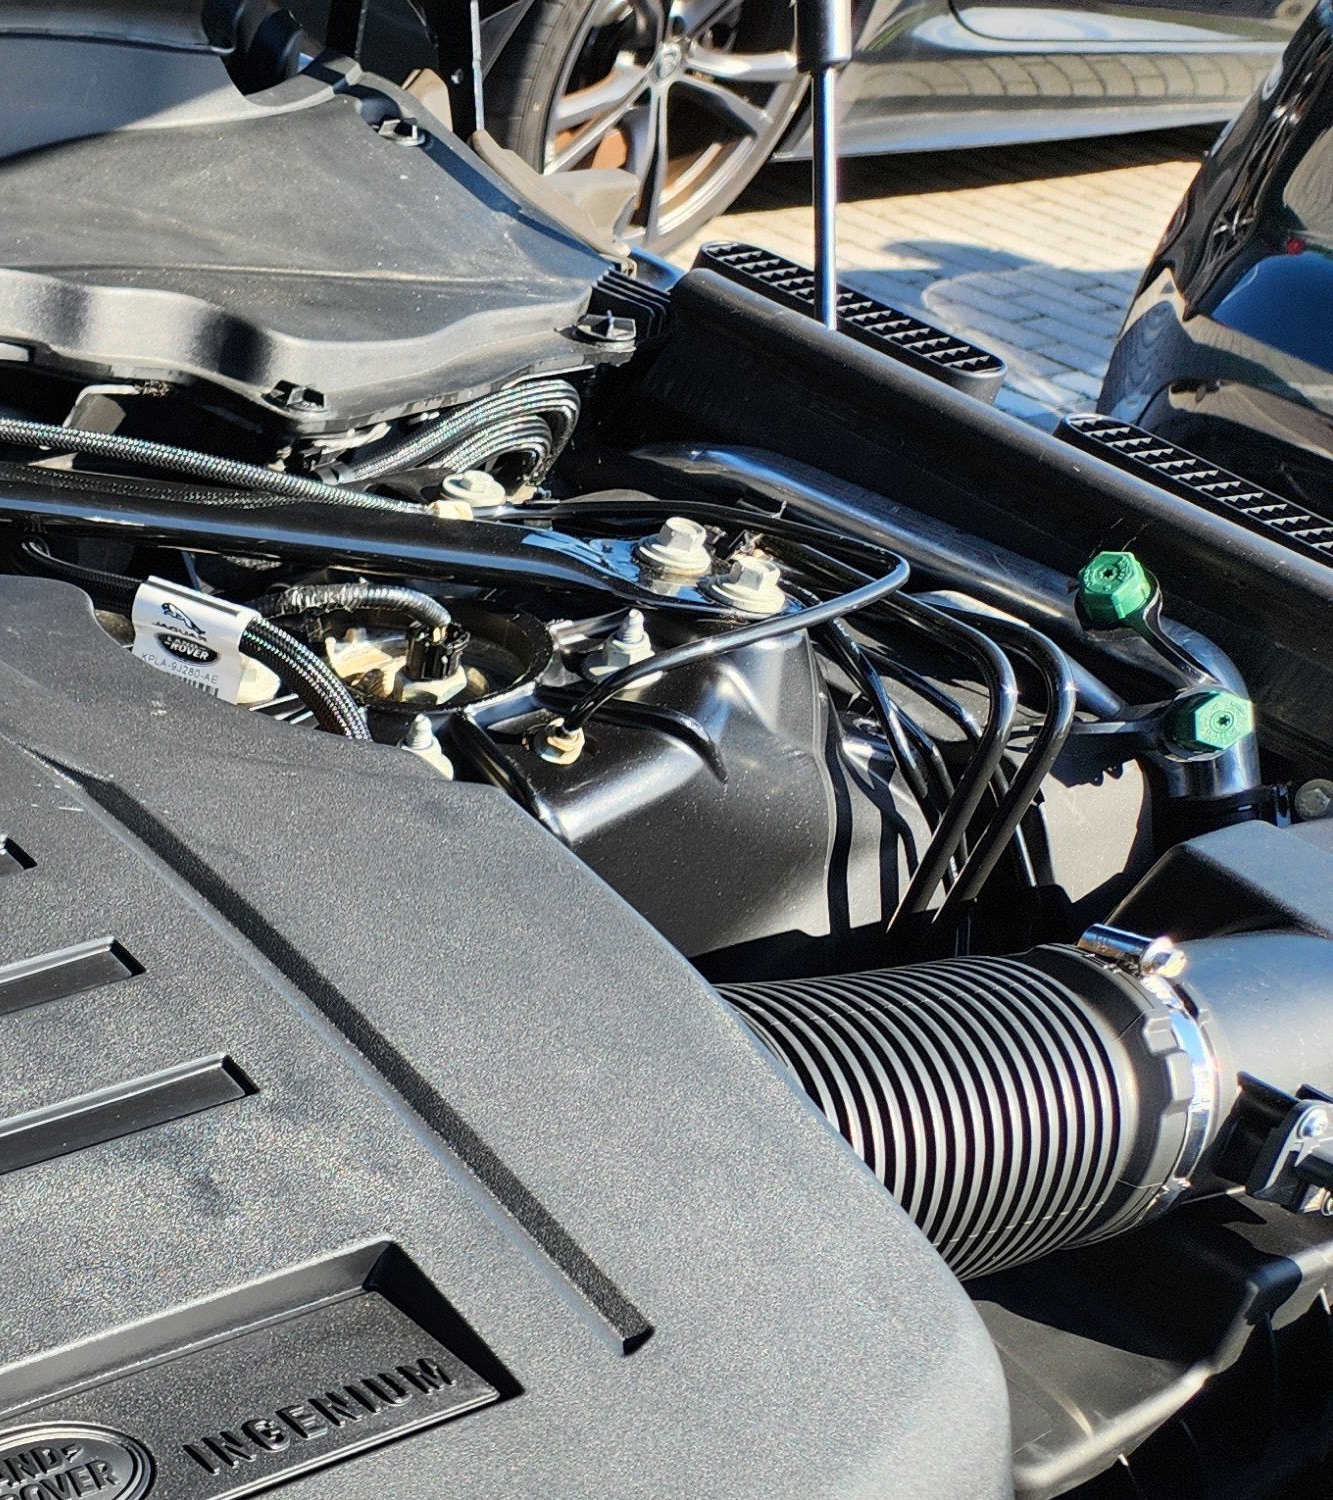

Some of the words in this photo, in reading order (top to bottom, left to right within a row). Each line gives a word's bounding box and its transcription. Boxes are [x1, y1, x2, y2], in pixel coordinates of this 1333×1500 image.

[170, 642, 210, 661] ROVER
[141, 652, 219, 686] KPLA-9J280-AE
[182, 1357, 458, 1475] INGENIUM
